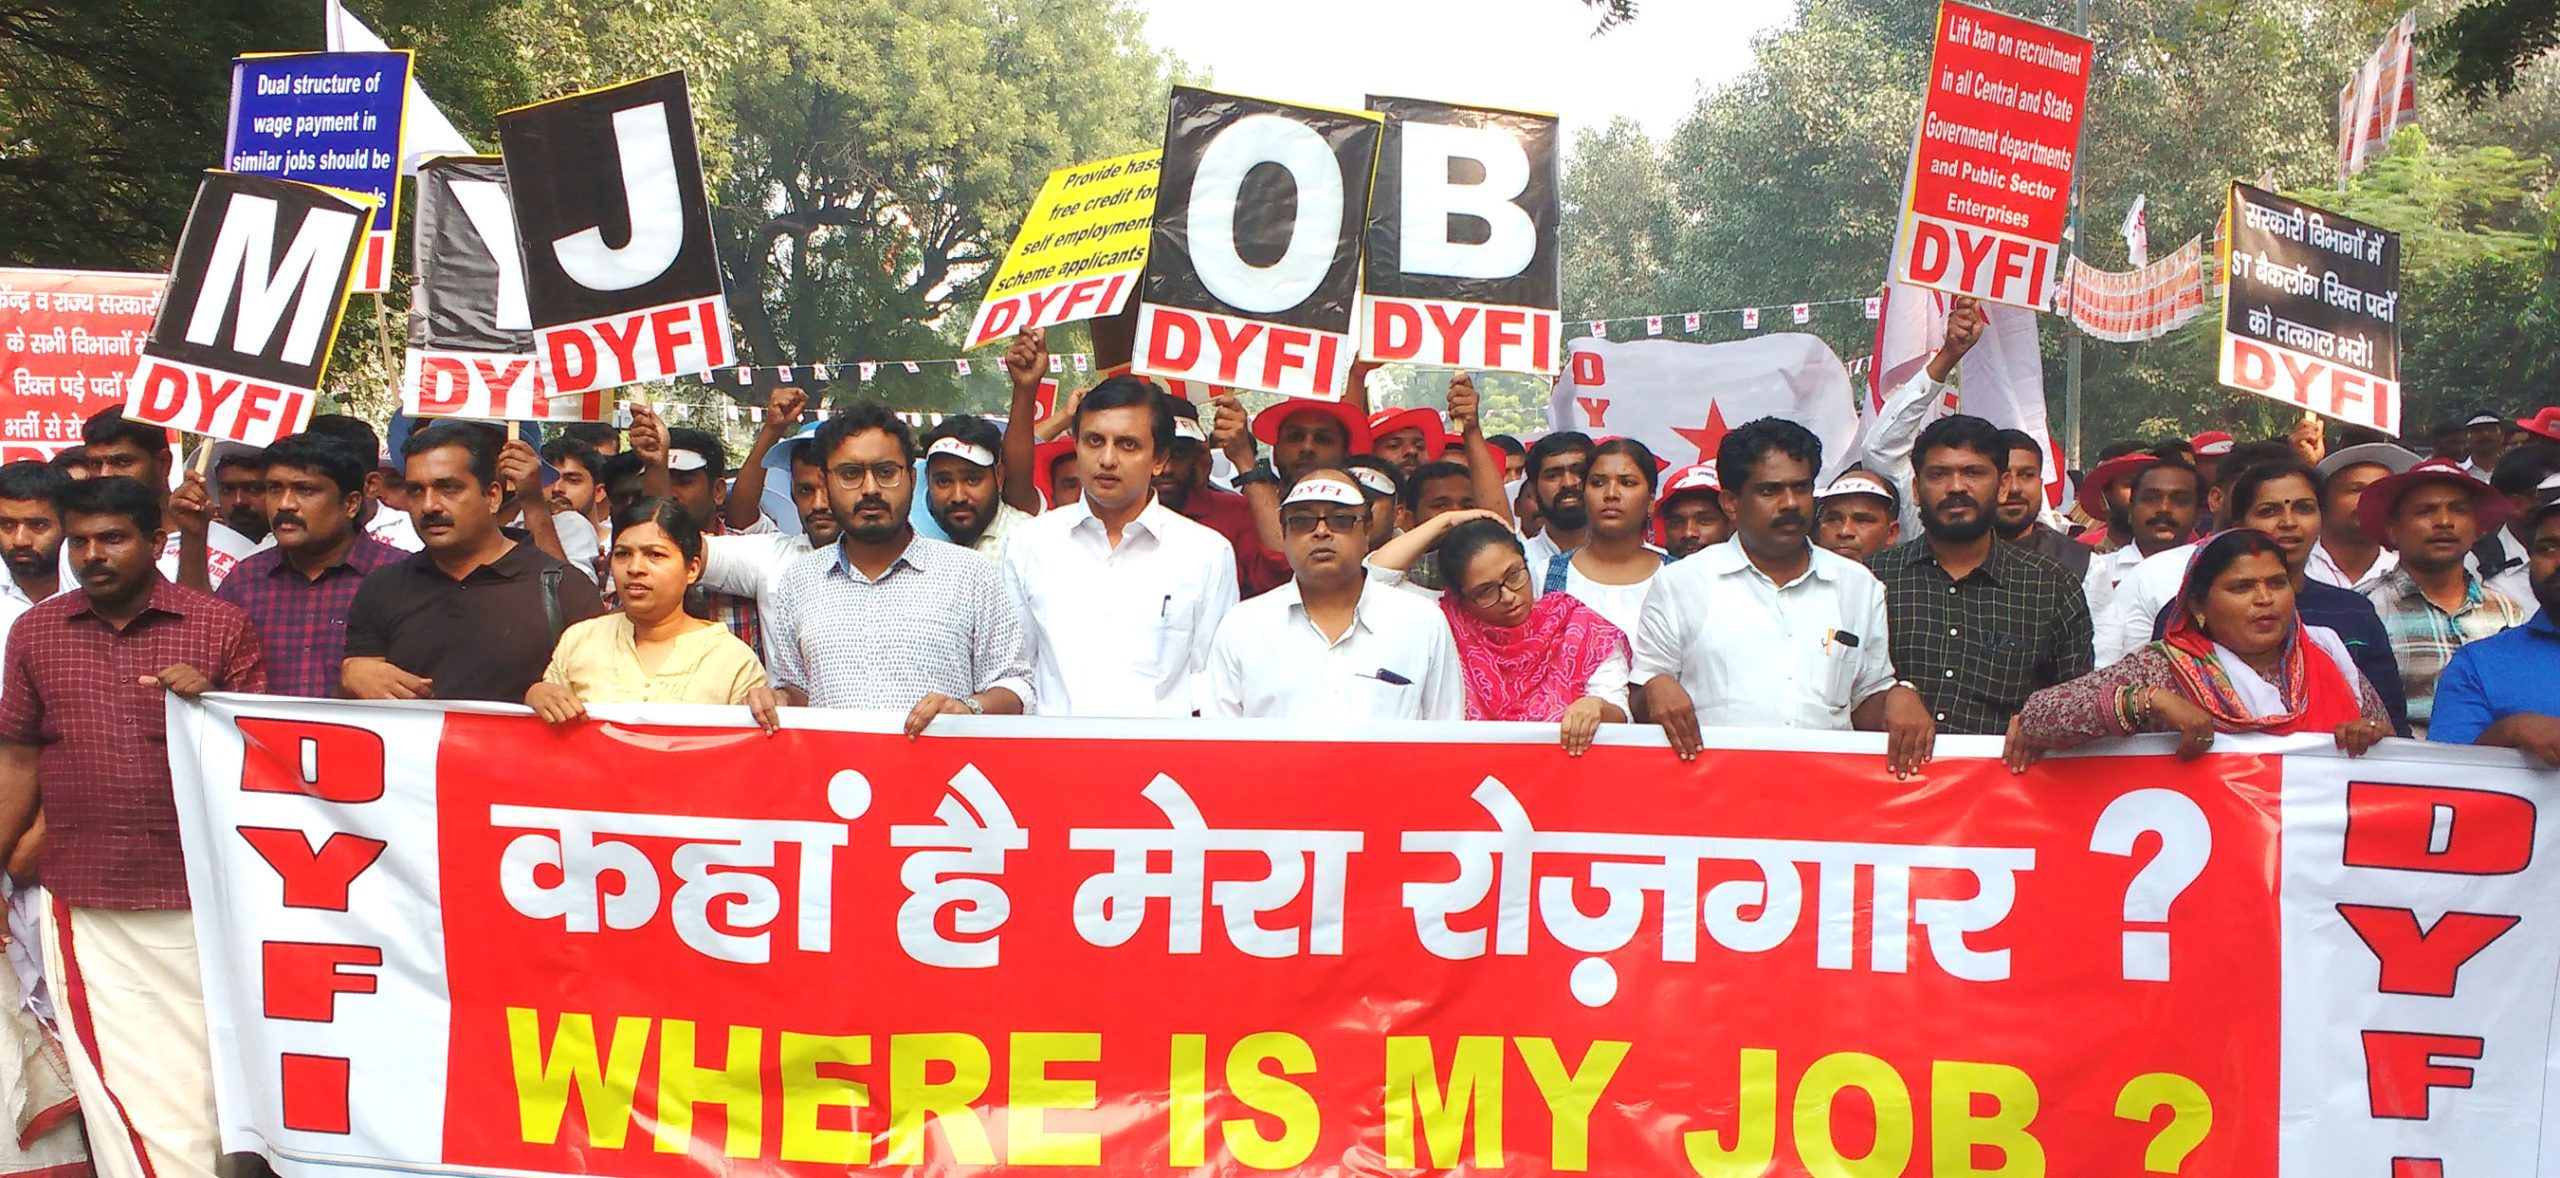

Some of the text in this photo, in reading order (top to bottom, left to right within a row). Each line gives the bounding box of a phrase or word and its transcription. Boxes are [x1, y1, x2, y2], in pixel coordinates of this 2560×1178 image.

[1948, 14, 2082, 77] Lift ban on recruitment
[257, 71, 382, 96] Dual structure of
[1941, 64, 2073, 123] in all Central and State
[254, 110, 377, 139] wage payment in
[1926, 111, 2072, 172] Government departments
[232, 148, 391, 177] similar jobs should be
[1062, 164, 1122, 190] Provide
[1931, 157, 2057, 201] and Public Sector
[552, 101, 684, 292] J
[1048, 186, 1158, 222] free credit for
[1187, 114, 1345, 314] O
[1399, 120, 1537, 280] B
[1947, 192, 2030, 229] Enterprises
[1021, 213, 1153, 257] self employment
[1908, 220, 2049, 306] DYFI
[2245, 202, 2385, 266] सरकारी विभागों में
[185, 192, 358, 367] M
[995, 244, 1145, 293] scheme applicants
[2231, 249, 2398, 324] ST बैकलॉग रिक्त पदों
[35, 292, 49, 311] व
[53, 292, 94, 314] राज्य
[975, 274, 1127, 344] DYFI
[6, 326, 25, 353] के
[30, 326, 67, 355] सभी
[71, 326, 132, 356] विभागों
[546, 301, 725, 393] DYFI
[1146, 309, 1338, 397] DYFI
[1373, 300, 1551, 372] DYFI
[2248, 303, 2374, 370] को तत्काल भरो!
[13, 367, 56, 396] रिक्त
[59, 370, 86, 404] पड़े
[90, 370, 121, 398] पदों
[137, 362, 305, 441] DYFI
[2232, 339, 2388, 429] DYFI
[4, 410, 86, 439] भर्ती से रो
[1290, 483, 1342, 498] DYFI
[489, 762, 2213, 1008] कहां है मेरा रोज़गार ?
[234, 715, 386, 1136] DYFI
[2335, 780, 2538, 1178] DYF
[506, 1006, 2215, 1178] WHERE IS MY JOB ?
